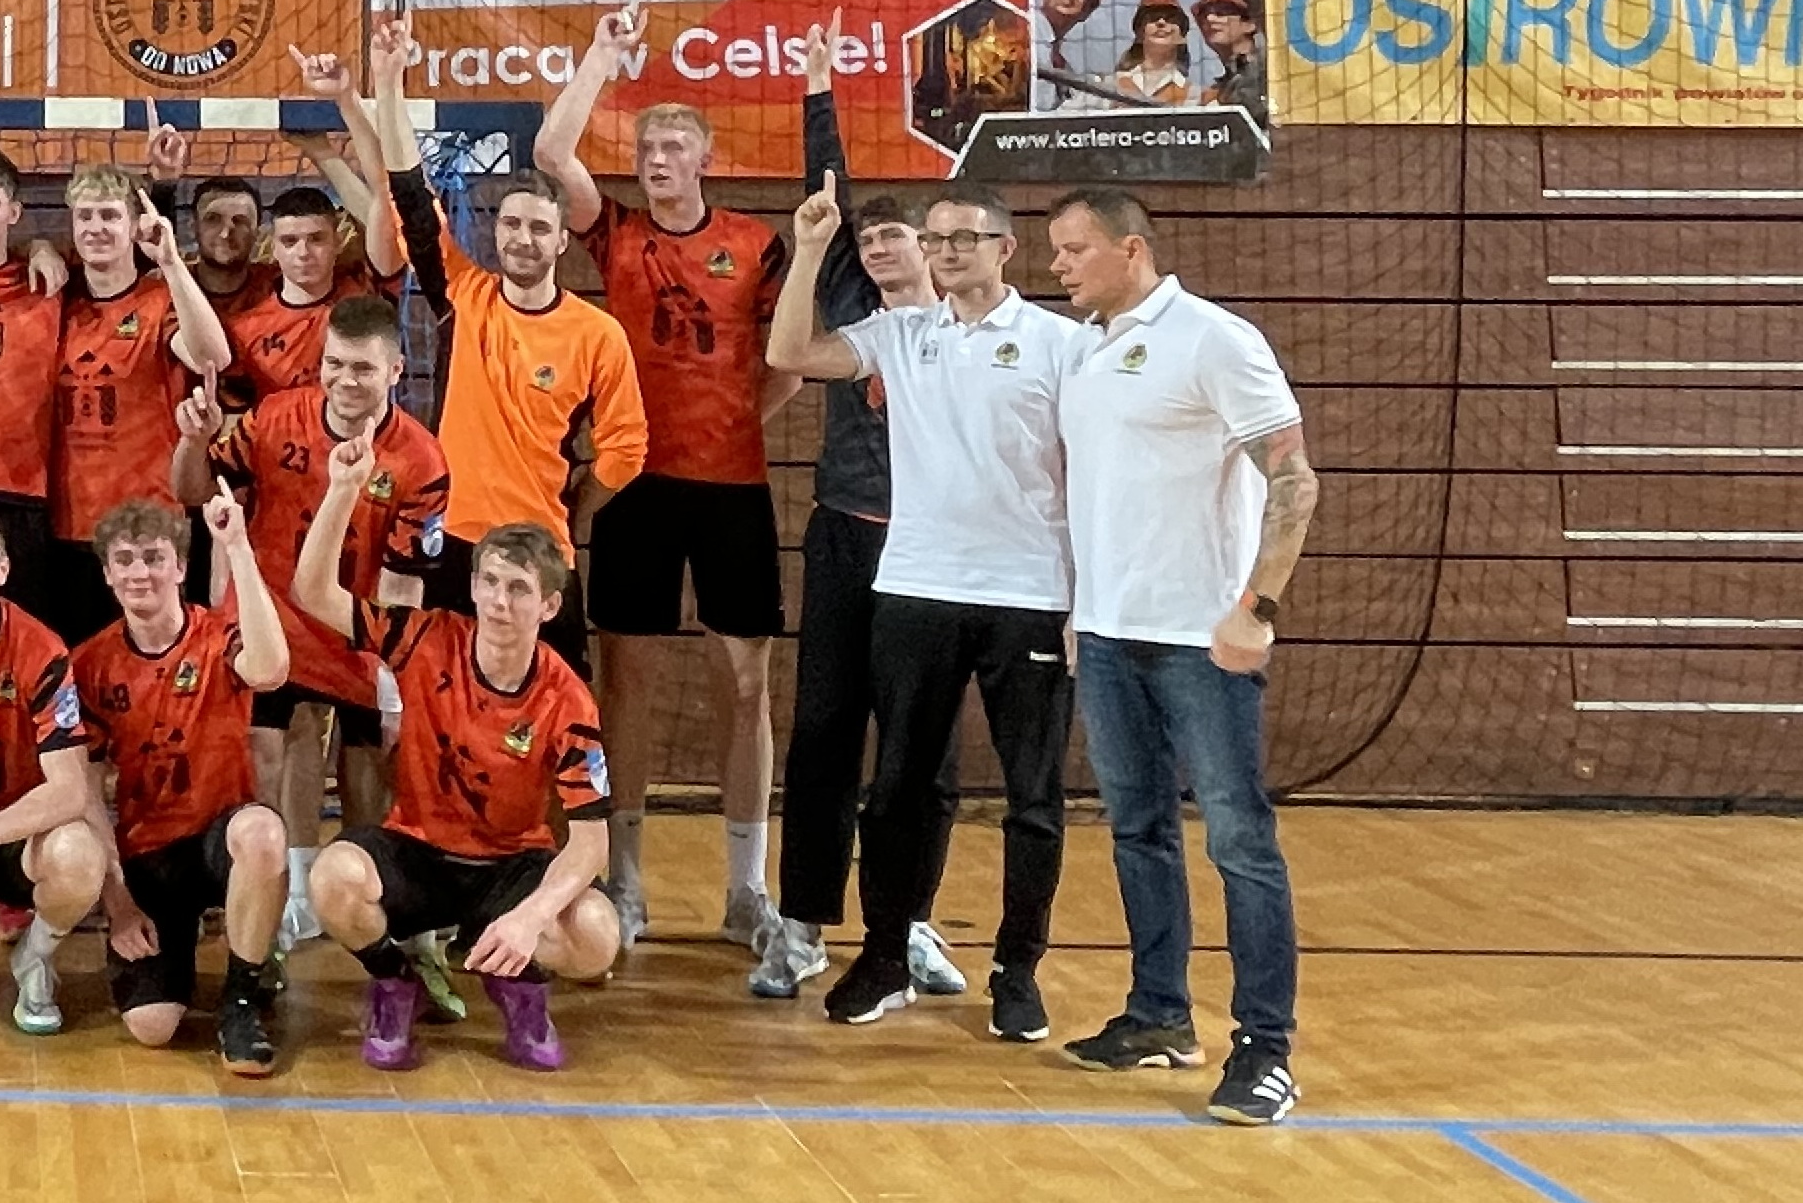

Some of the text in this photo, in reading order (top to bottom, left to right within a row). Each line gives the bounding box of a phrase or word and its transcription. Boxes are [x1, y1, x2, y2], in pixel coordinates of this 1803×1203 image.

[172, 46, 228, 76] NOWA
[672, 22, 888, 81] Celse!
[280, 441, 310, 475] 23
